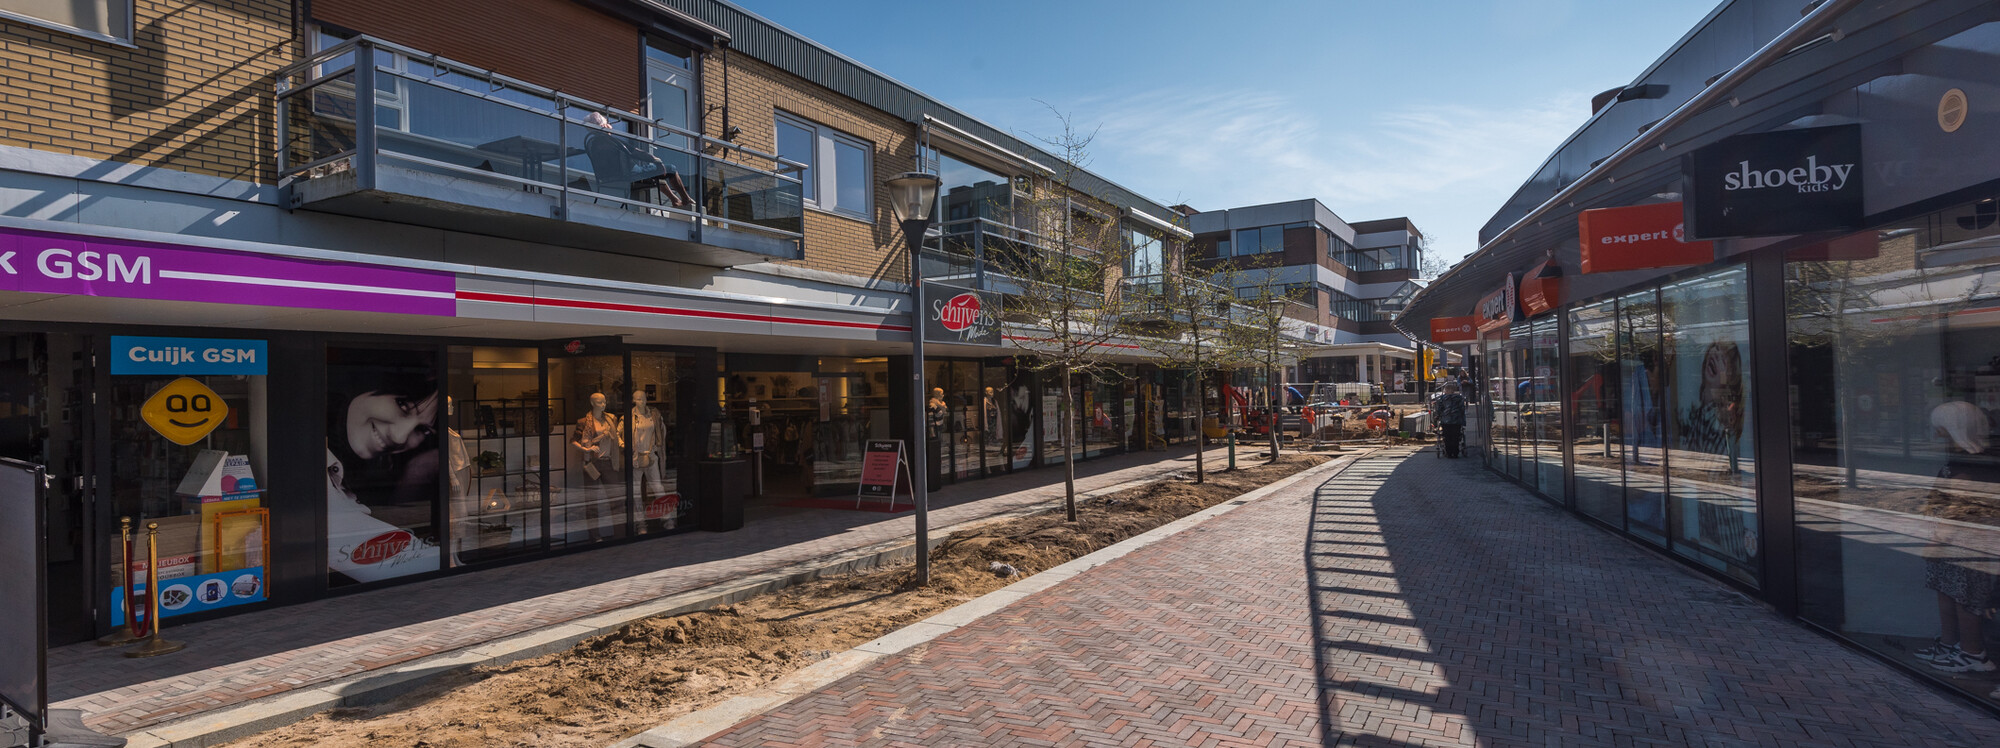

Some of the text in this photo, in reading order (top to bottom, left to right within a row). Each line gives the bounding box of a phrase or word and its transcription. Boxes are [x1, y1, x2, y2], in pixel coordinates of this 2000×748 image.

[1724, 155, 1855, 191] shoeby
[1798, 181, 1829, 193] kids
[1601, 230, 1668, 244] expert
[37, 248, 151, 284] GSM
[932, 296, 995, 340] Schijvens
[1482, 289, 1506, 320] expert
[1435, 326, 1461, 334] expert
[128, 346, 256, 365] Cuijk GSM
[337, 532, 435, 568] Schijvens
